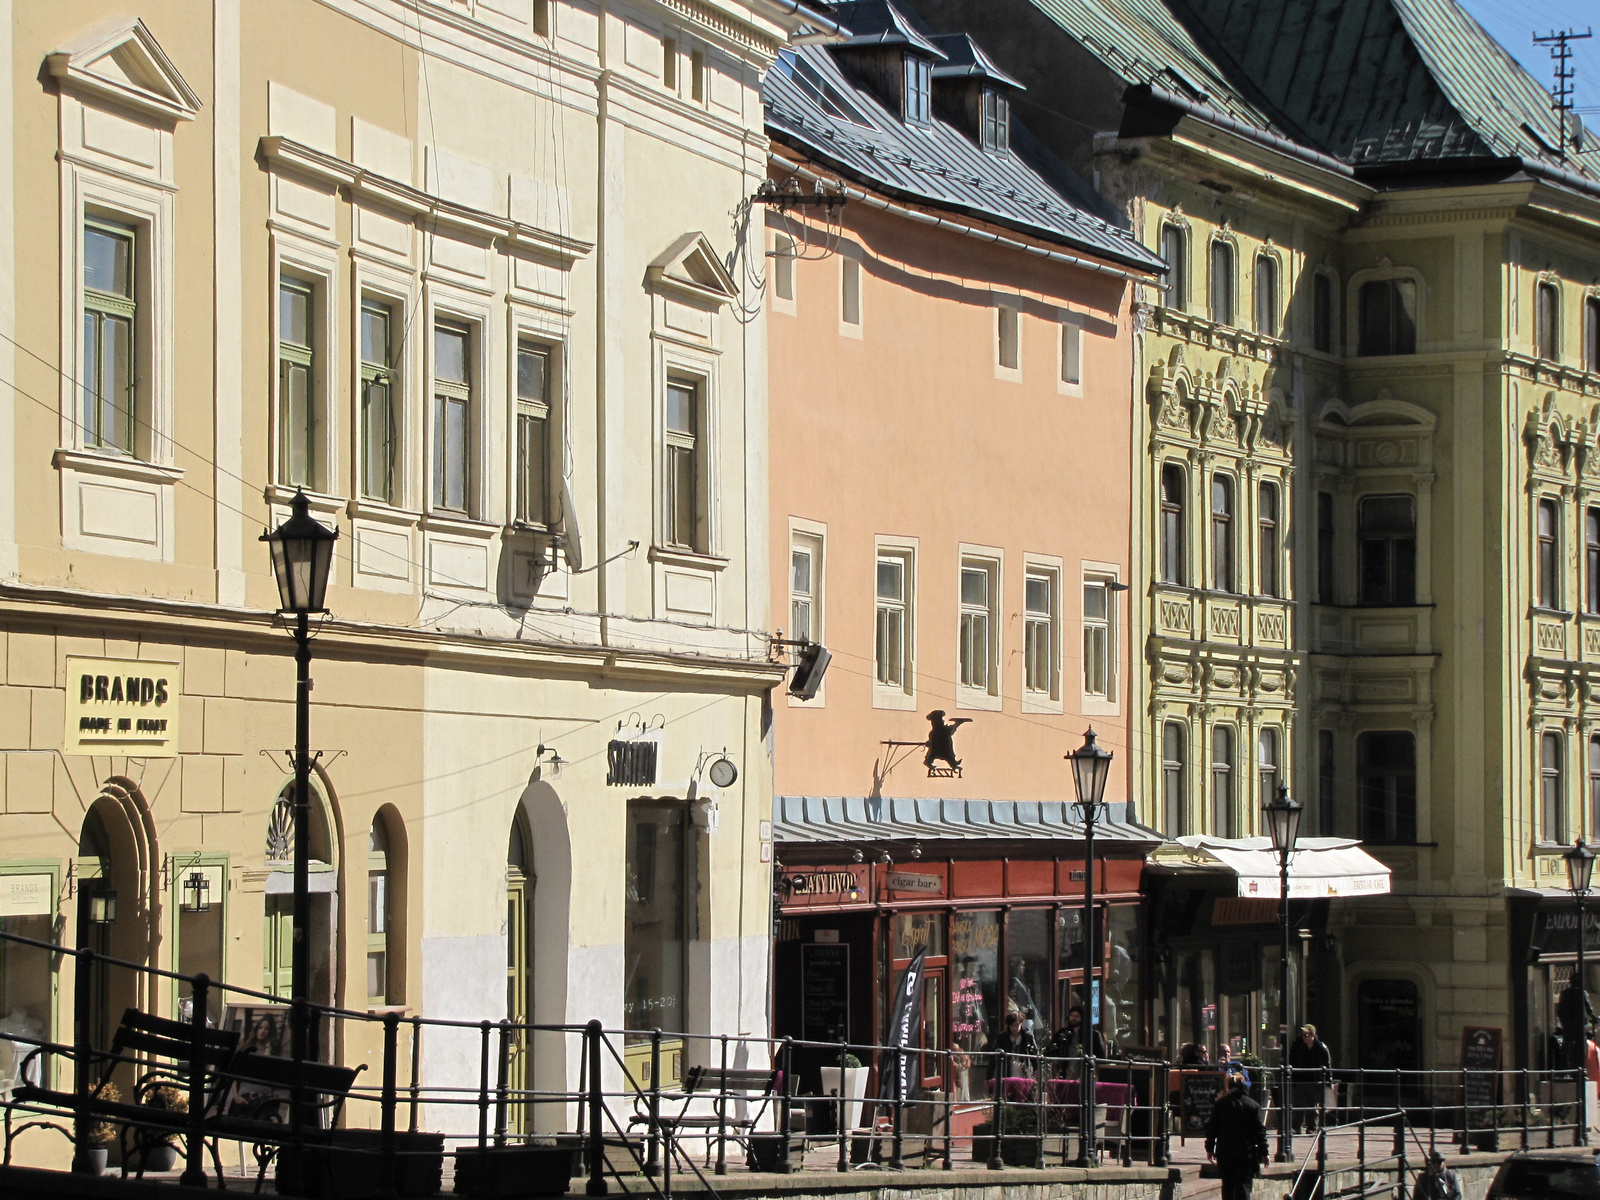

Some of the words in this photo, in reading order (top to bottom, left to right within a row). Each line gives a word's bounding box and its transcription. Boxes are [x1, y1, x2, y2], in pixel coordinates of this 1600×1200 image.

[80, 674, 168, 704] BRANDS
[79, 716, 112, 731] MADE
[117, 718, 131, 731] IN
[137, 718, 168, 732] ITALY
[11, 883, 39, 893] BRANDS
[892, 876, 915, 888] cigar
[917, 877, 933, 889] bar
